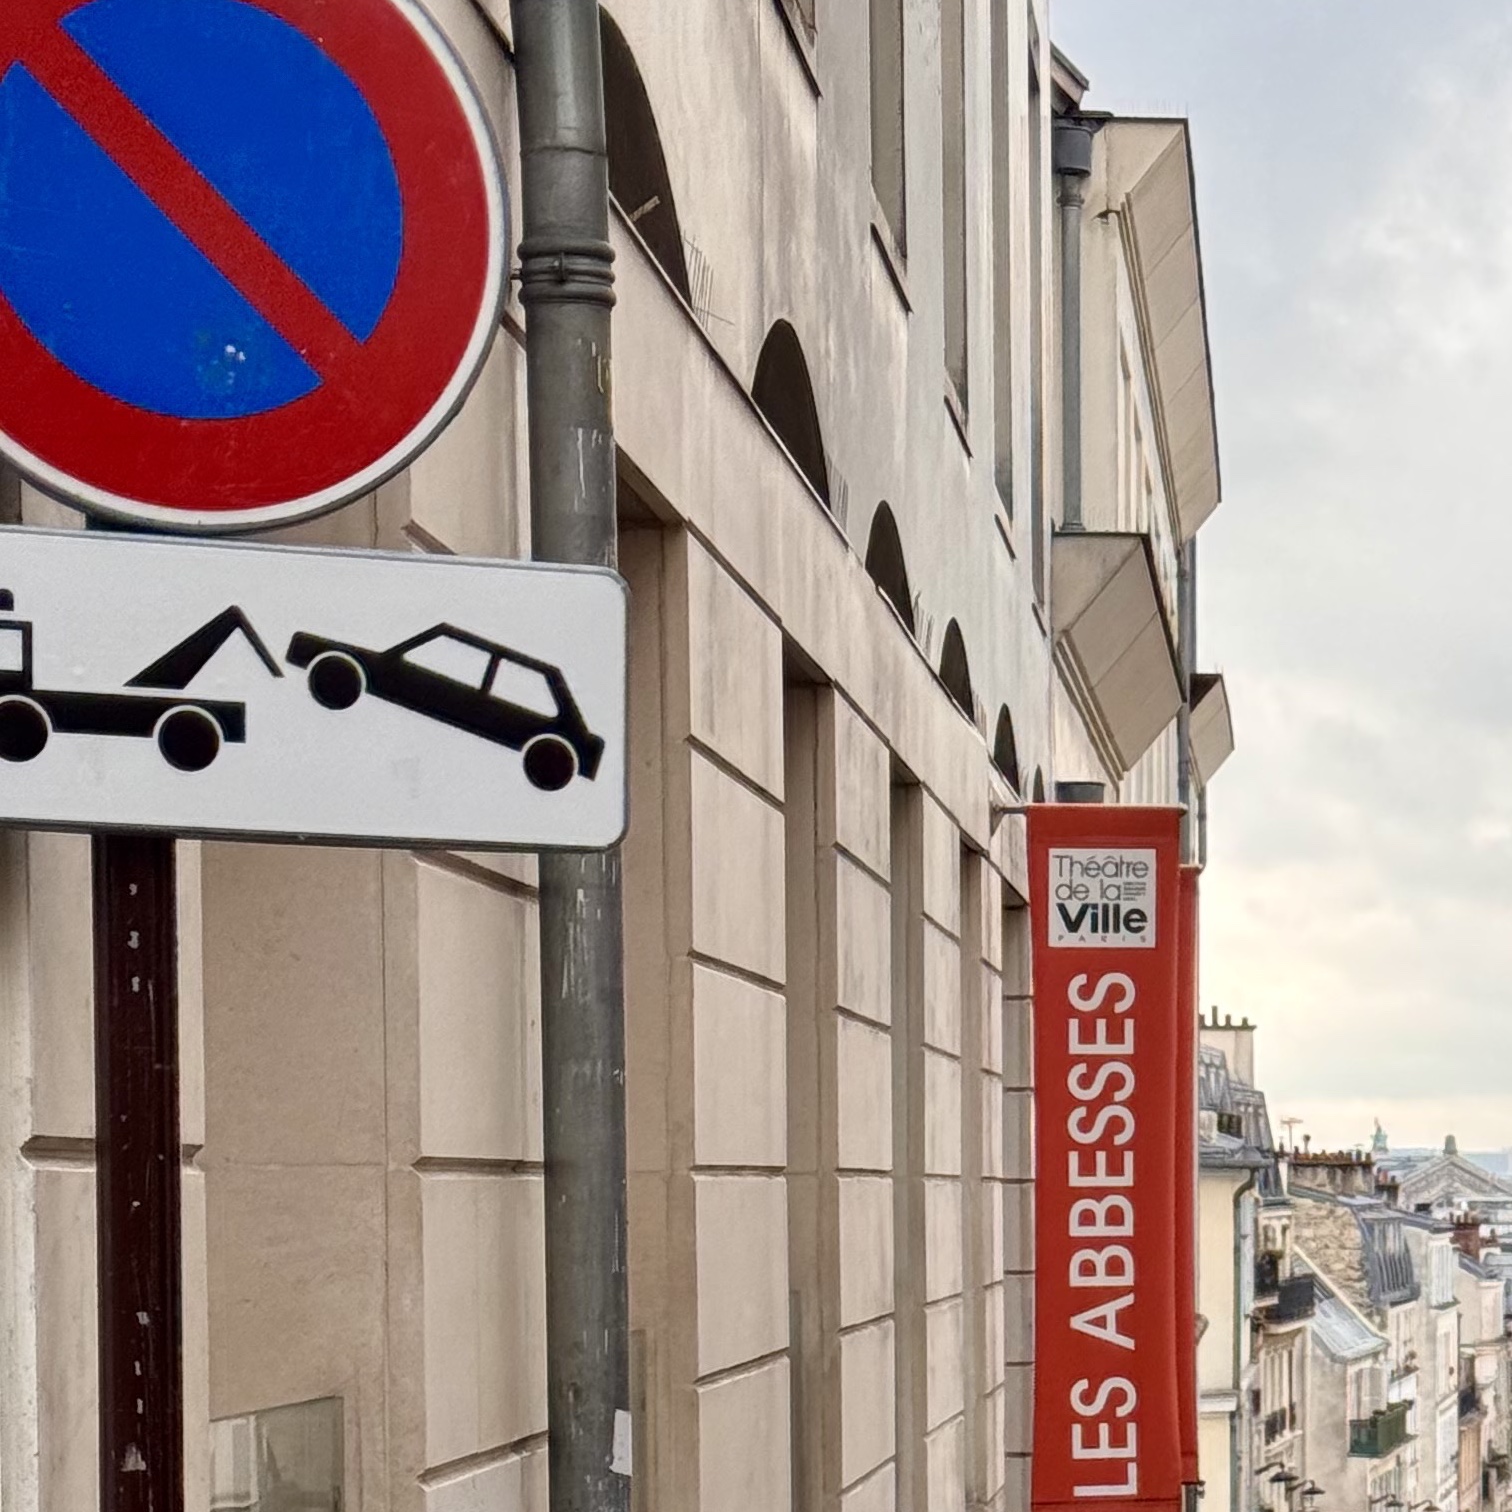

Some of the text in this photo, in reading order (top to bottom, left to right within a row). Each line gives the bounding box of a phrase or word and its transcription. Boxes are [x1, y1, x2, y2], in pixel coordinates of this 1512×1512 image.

[1052, 855, 1149, 878] Théâtre
[1055, 878, 1090, 901] de
[1100, 879, 1121, 901] la
[1056, 903, 1148, 934] Ville
[1067, 973, 1138, 1497] LES ABBESSES
